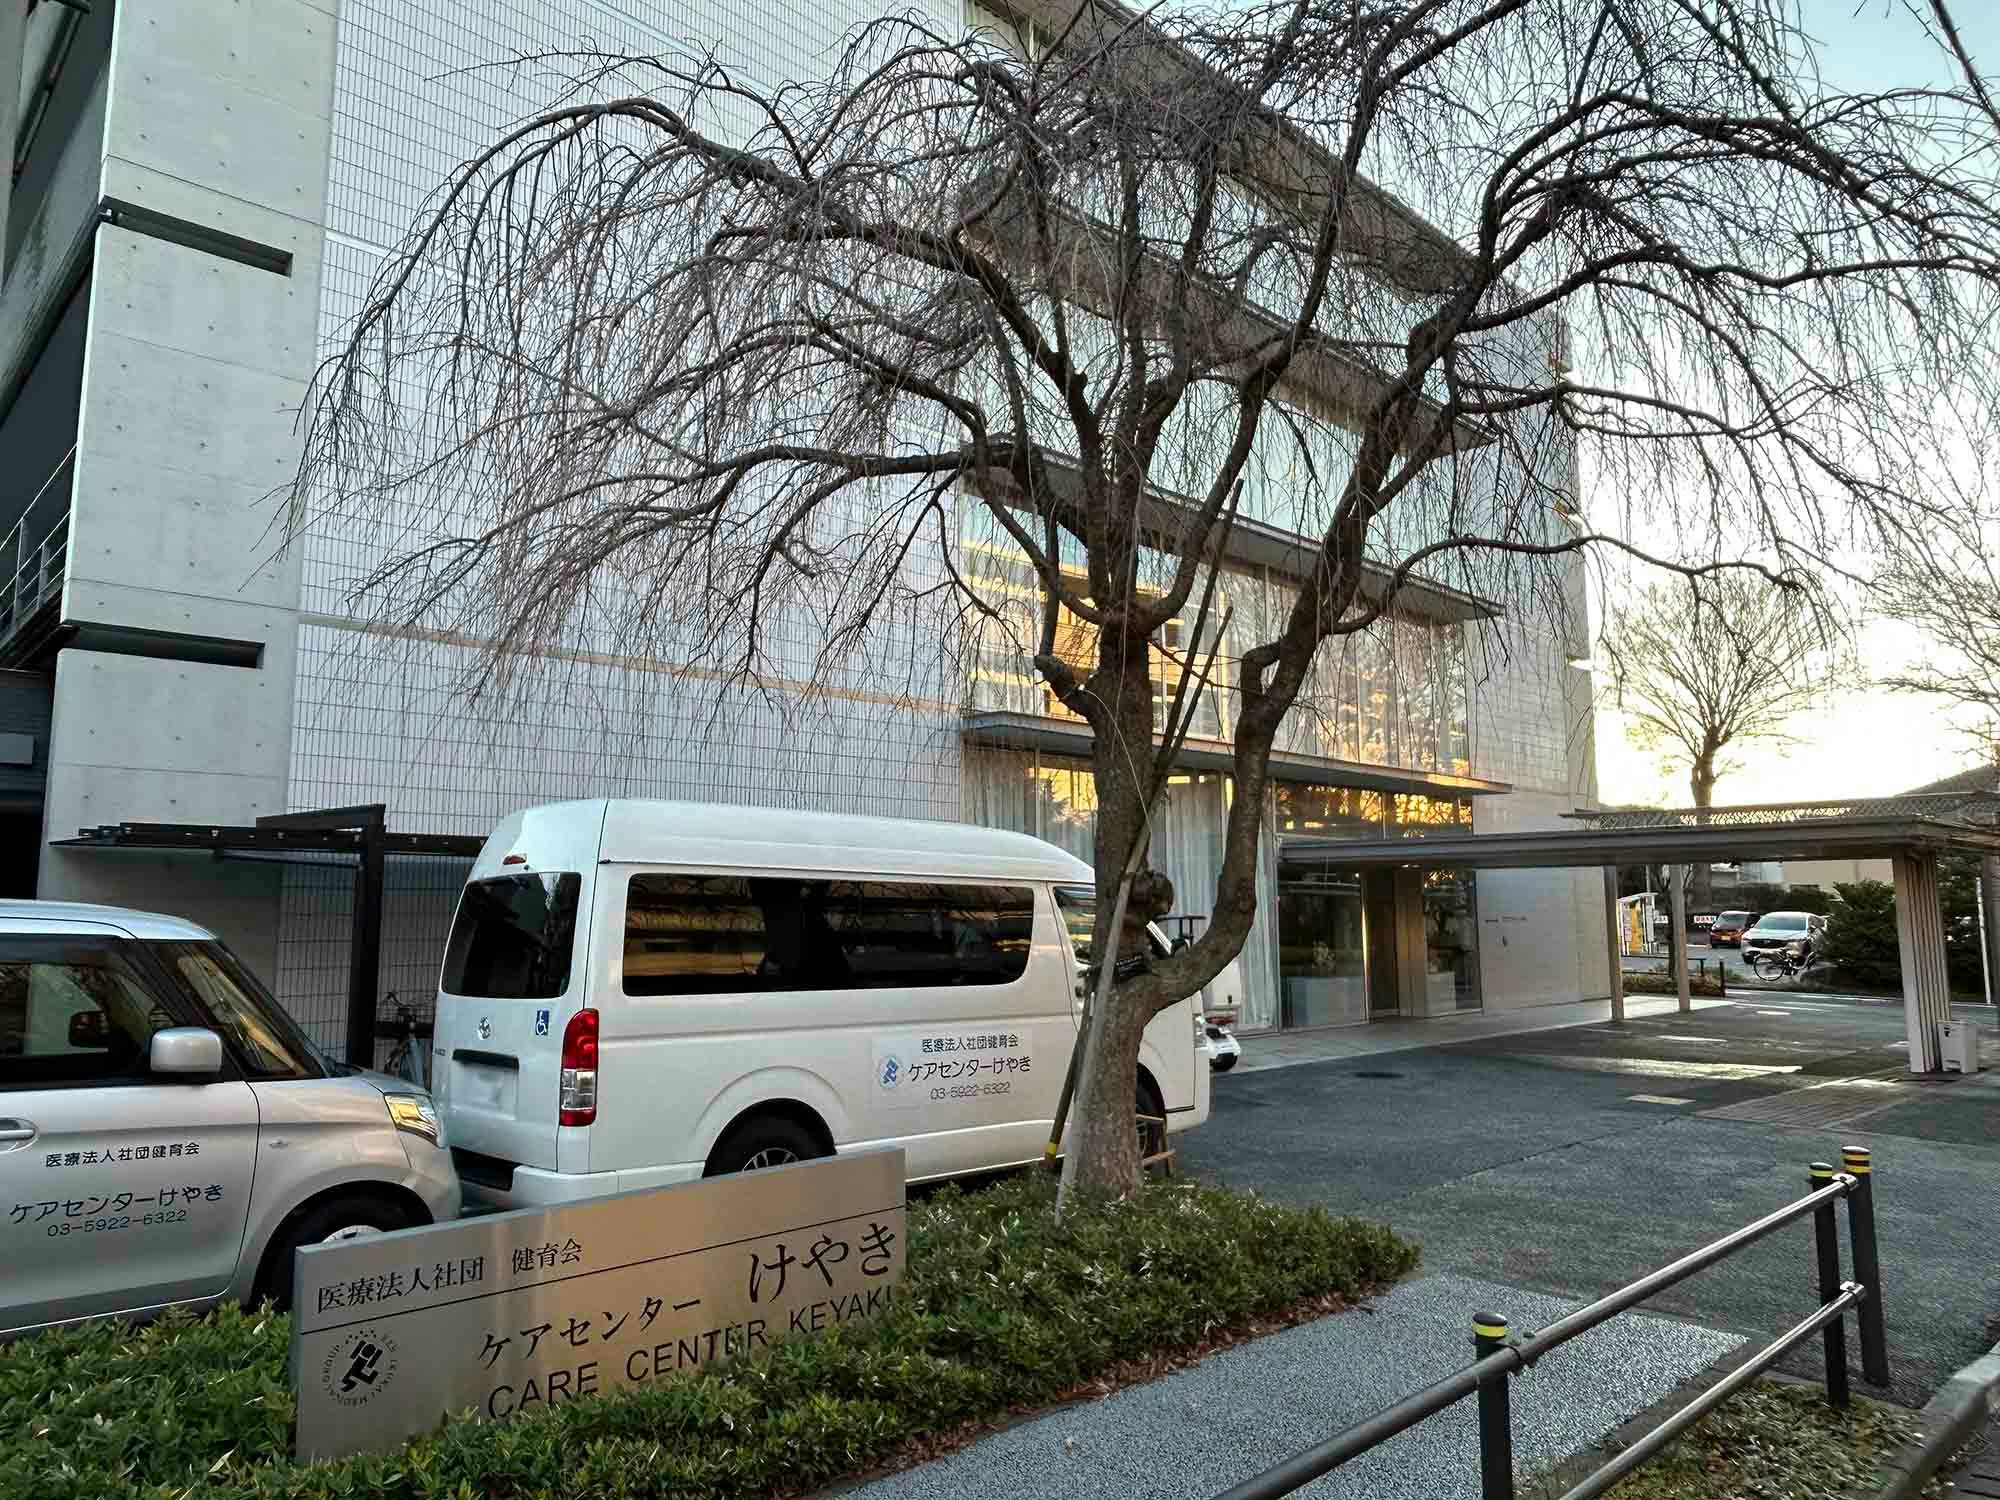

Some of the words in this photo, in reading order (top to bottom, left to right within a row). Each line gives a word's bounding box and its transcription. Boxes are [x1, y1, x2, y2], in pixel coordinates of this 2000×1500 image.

[922, 1034, 1018, 1053] 医療法人社団健育会
[908, 1055, 1031, 1082] ケアセンターけやき
[930, 1081, 1010, 1100] 03-5922-6322
[45, 1142, 200, 1168] 医療法人社団健育会
[9, 1184, 224, 1224] ケアセンターけやき
[47, 1209, 187, 1237] 03-5922-6322
[317, 1256, 484, 1314] 医療法人社団
[511, 1238, 582, 1275] 健育会
[478, 1297, 701, 1370] ケアセンター
[749, 1222, 896, 1304] けやき
[488, 1361, 599, 1419] CARE
[626, 1319, 767, 1382] CENTER
[789, 1285, 892, 1334] KEYAKI
